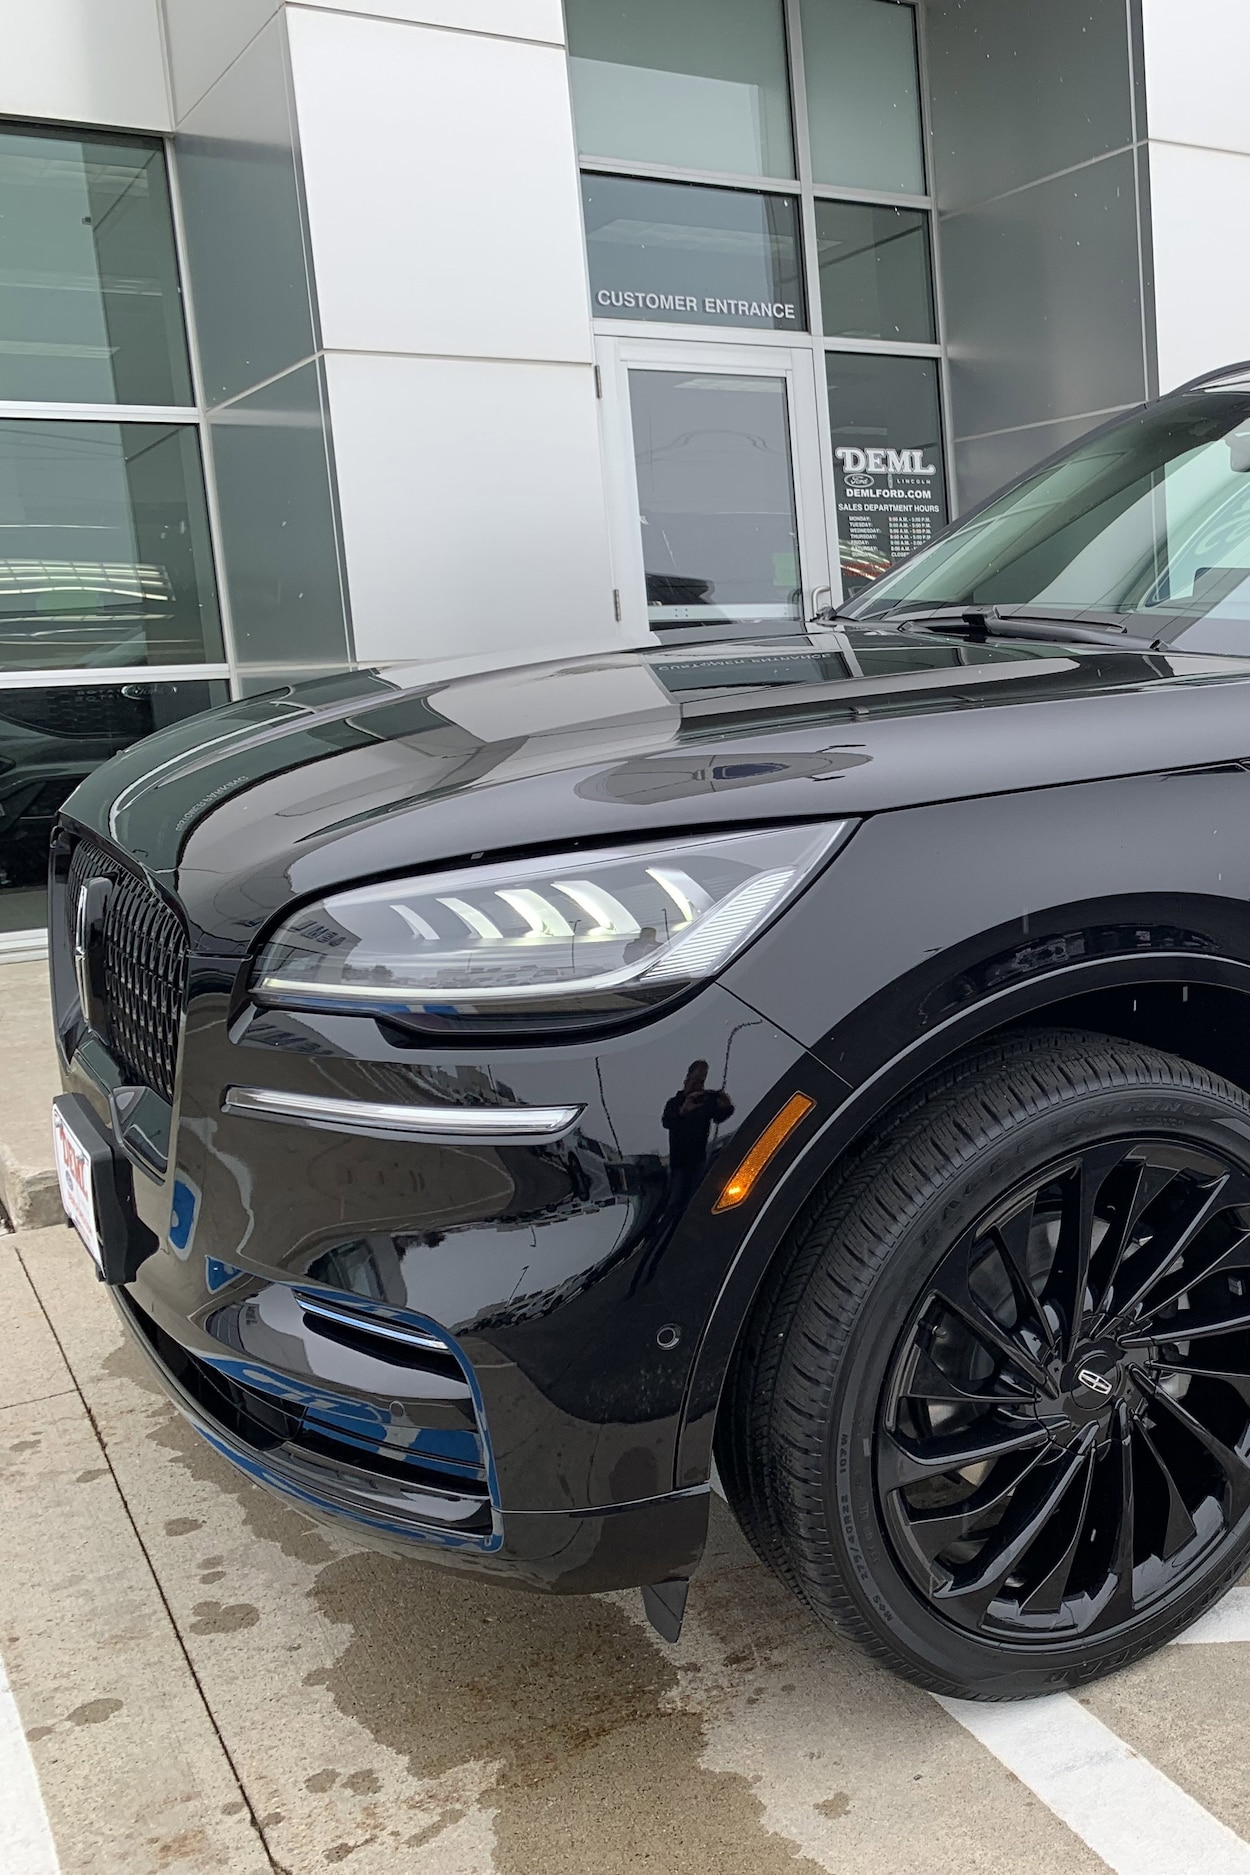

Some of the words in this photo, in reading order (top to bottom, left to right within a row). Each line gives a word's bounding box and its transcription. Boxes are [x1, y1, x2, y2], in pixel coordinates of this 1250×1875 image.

[597, 290, 698, 312] CUSTOMER
[705, 298, 796, 319] ENTRANCE
[835, 447, 936, 475] DEML
[846, 488, 932, 499] DEMLFORD.COM
[838, 503, 863, 511] SALES
[864, 504, 913, 512] DEPARTMENT
[914, 505, 940, 513] HOURS
